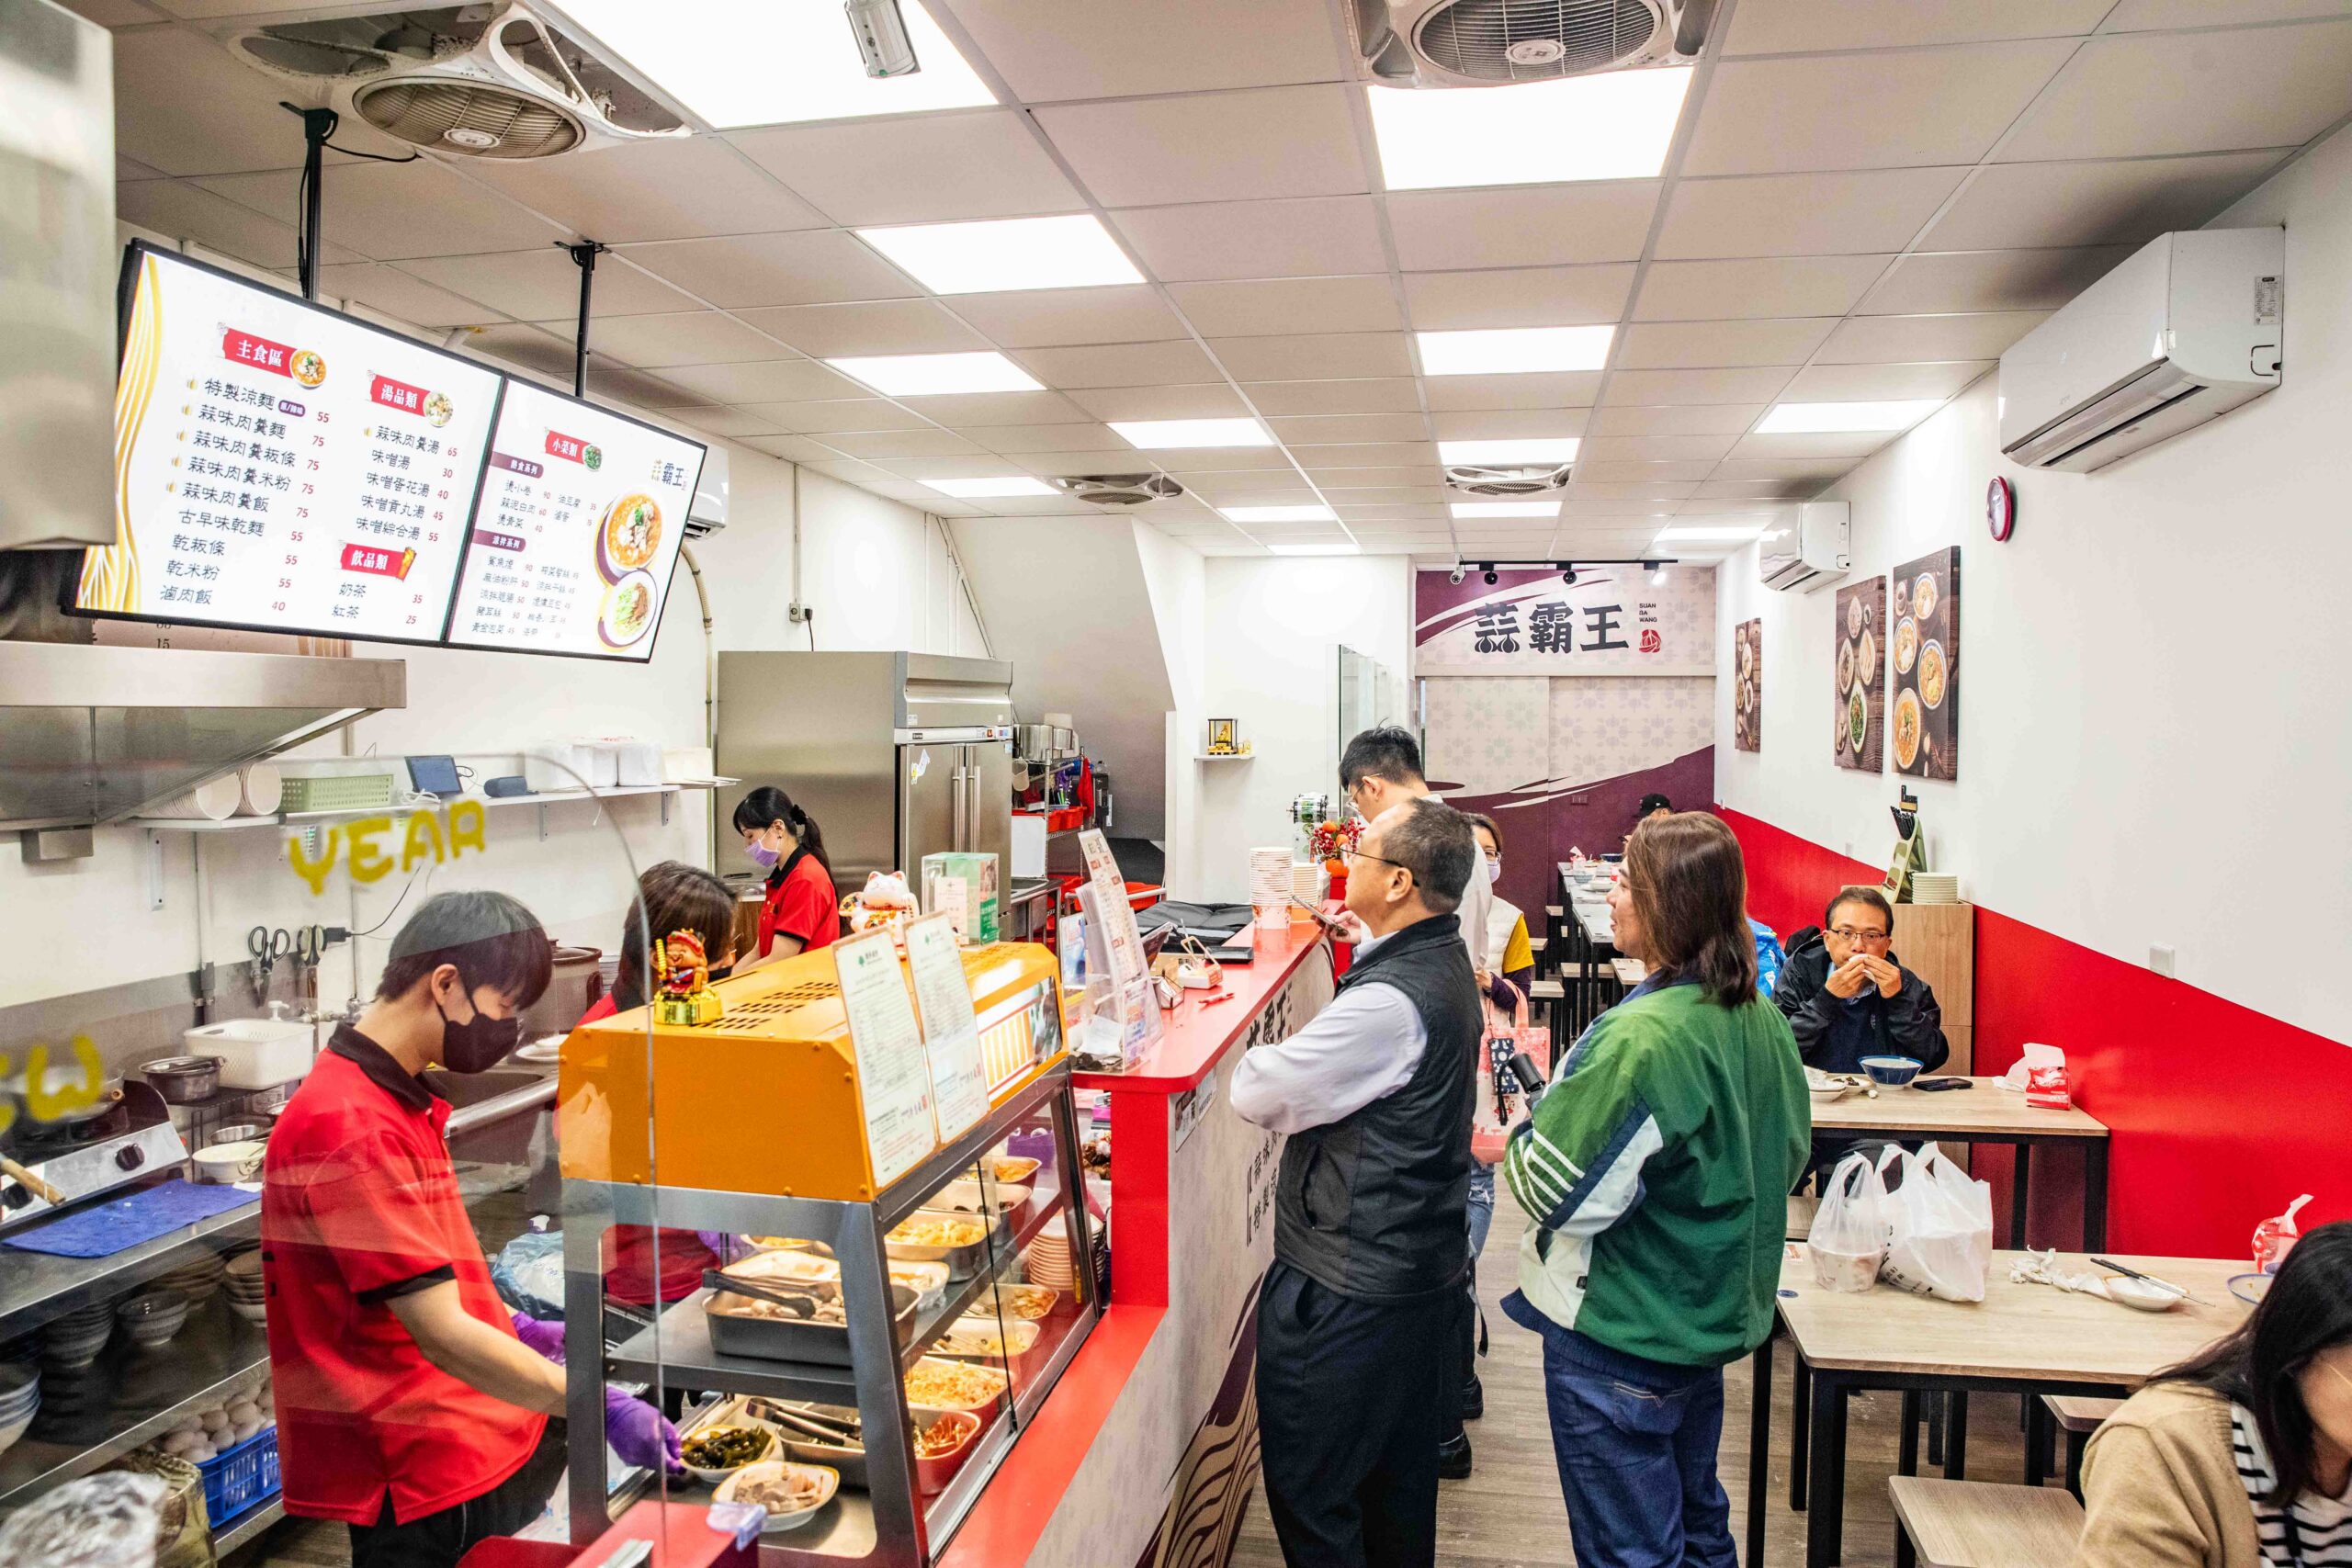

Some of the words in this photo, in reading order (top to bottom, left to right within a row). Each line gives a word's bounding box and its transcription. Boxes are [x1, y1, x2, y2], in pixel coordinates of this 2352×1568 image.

[236, 340, 283, 367] 主食區
[204, 378, 276, 411] 特製涼麵
[317, 412, 330, 423] 55
[381, 384, 418, 409] 湯品類
[198, 404, 286, 439] 蒜味肉羹麵
[312, 435, 324, 446] 75
[376, 425, 440, 455] 蒜味肉羹湯
[447, 447, 458, 457] 65
[552, 438, 579, 457] 小菜類
[187, 457, 291, 491] 蒜味肉羹米粉
[301, 483, 314, 494] 75
[307, 459, 320, 470] 75
[372, 449, 411, 469] 味噌湯
[442, 468, 453, 478] 30
[182, 482, 270, 513] 蒜味肉羹飯
[296, 507, 309, 518] 75
[367, 472, 430, 497] 味噌蛋花湯
[437, 490, 448, 500] 40
[361, 494, 425, 519] 味噌貢丸湯
[433, 511, 444, 521] 45
[178, 509, 266, 537] 古早味乾麵
[290, 531, 303, 542] 55
[356, 516, 421, 540] 味噌綜合湯
[428, 532, 439, 542] 55
[285, 555, 298, 565] 55
[351, 549, 389, 570] 飲品類
[165, 559, 220, 581] 乾米粉
[278, 578, 291, 589] 55
[160, 584, 213, 604] 滷肉飯
[272, 602, 286, 612] 40
[339, 582, 367, 598] 奶茶
[413, 594, 423, 604] 35
[332, 604, 359, 619] 紅茶
[406, 615, 417, 625] 25
[1474, 601, 1630, 654] 蒜霸王
[289, 800, 486, 897] YEAR
